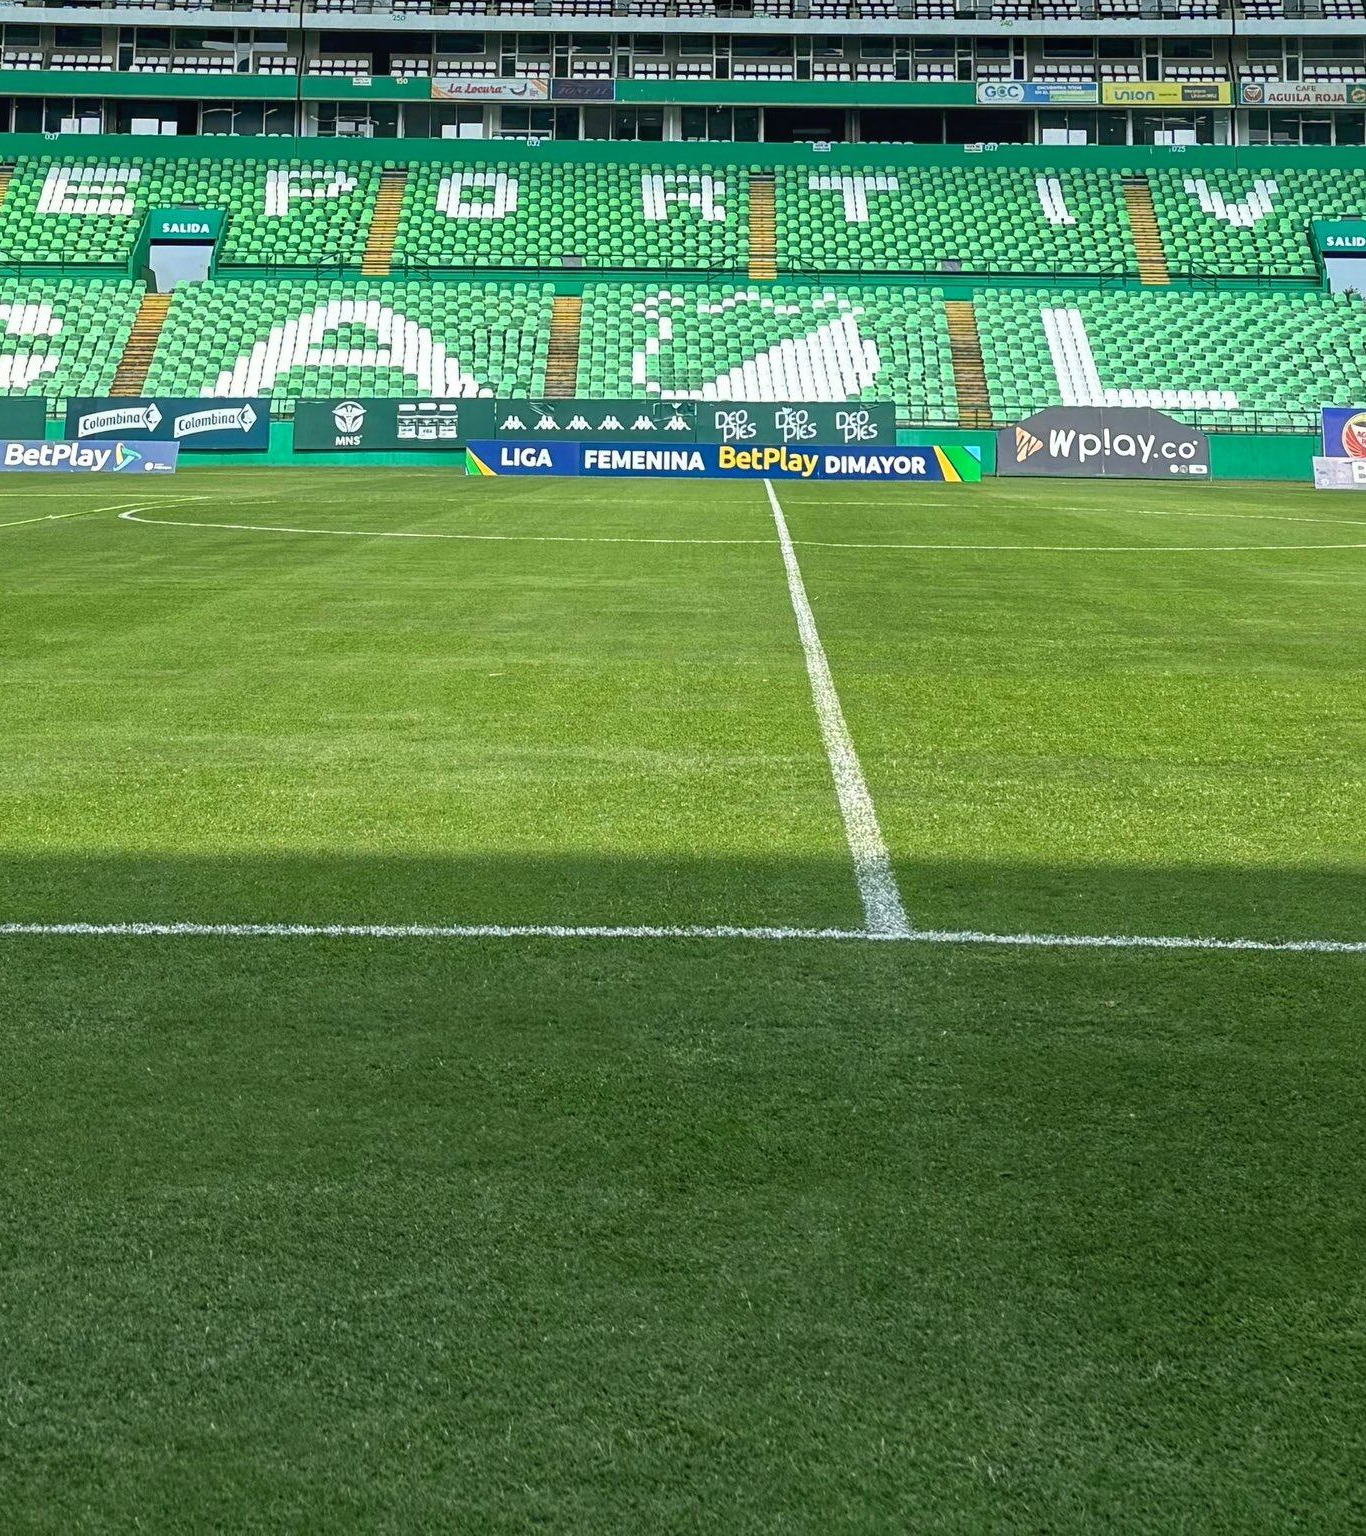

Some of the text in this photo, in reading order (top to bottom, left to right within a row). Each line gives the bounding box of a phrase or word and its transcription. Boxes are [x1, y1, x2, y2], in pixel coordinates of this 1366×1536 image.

[447, 83, 503, 94] La Locura
[1268, 93, 1345, 102] AGUILA ROJA
[162, 222, 209, 234] SALIDA
[83, 412, 141, 432] Colombina
[178, 412, 235, 432] Colombina
[715, 410, 748, 430] DEO
[775, 409, 809, 430] DEO
[835, 410, 869, 430] DEO
[335, 436, 361, 446] MNS
[723, 422, 757, 442] PIES
[783, 422, 817, 443] PIES
[844, 422, 878, 444] PIES
[4, 442, 112, 472] BetPlay
[501, 446, 926, 477] LIGA FEMENINA BetPlay DIMAYOR
